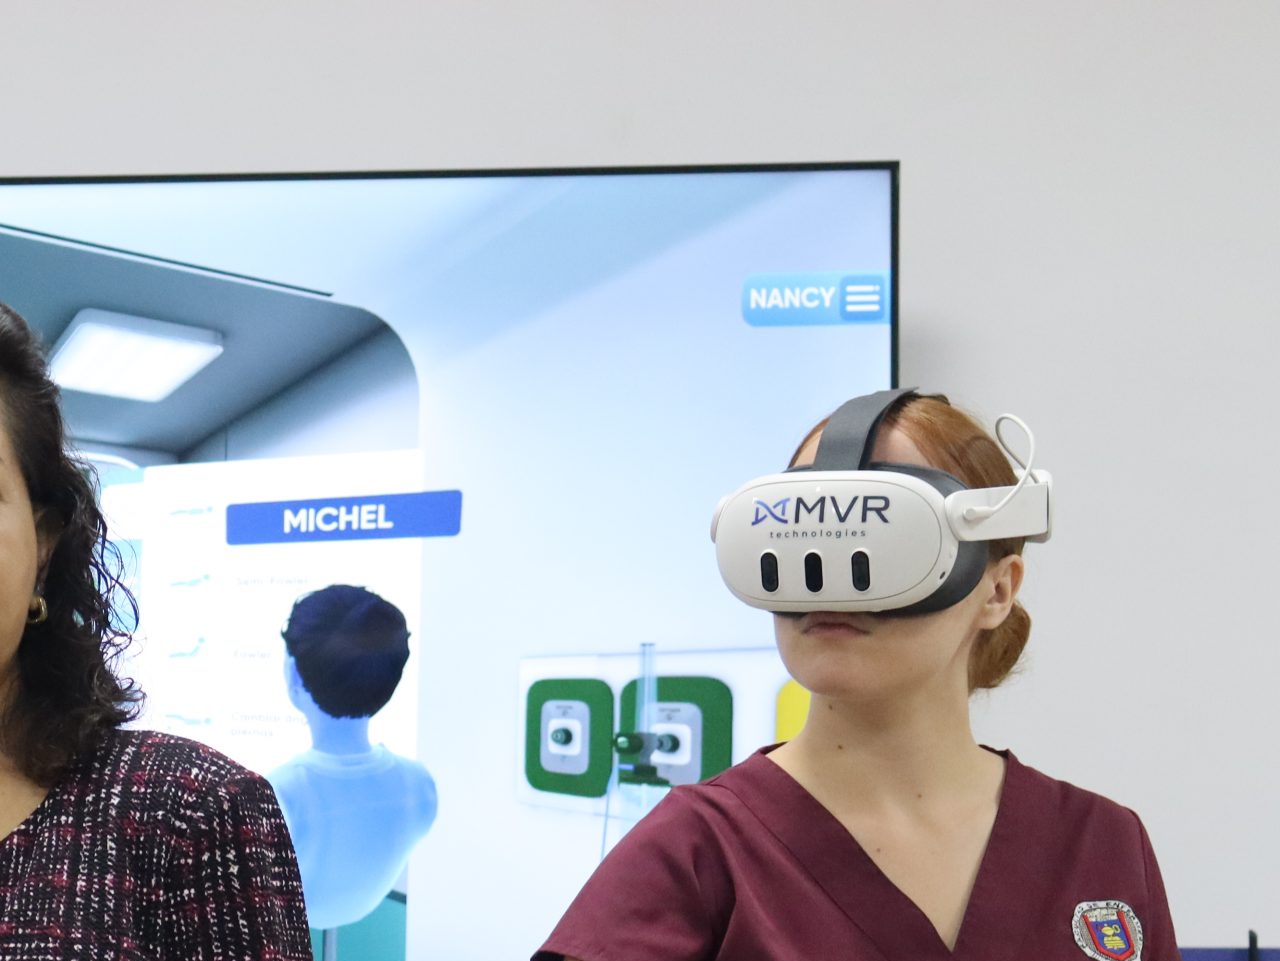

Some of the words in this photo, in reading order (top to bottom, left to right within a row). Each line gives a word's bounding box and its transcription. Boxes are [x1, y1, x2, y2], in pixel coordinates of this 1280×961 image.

[749, 286, 836, 310] NANCY
[283, 504, 394, 534] MICHEL
[794, 496, 890, 523] MVR
[770, 529, 867, 538] technologies
